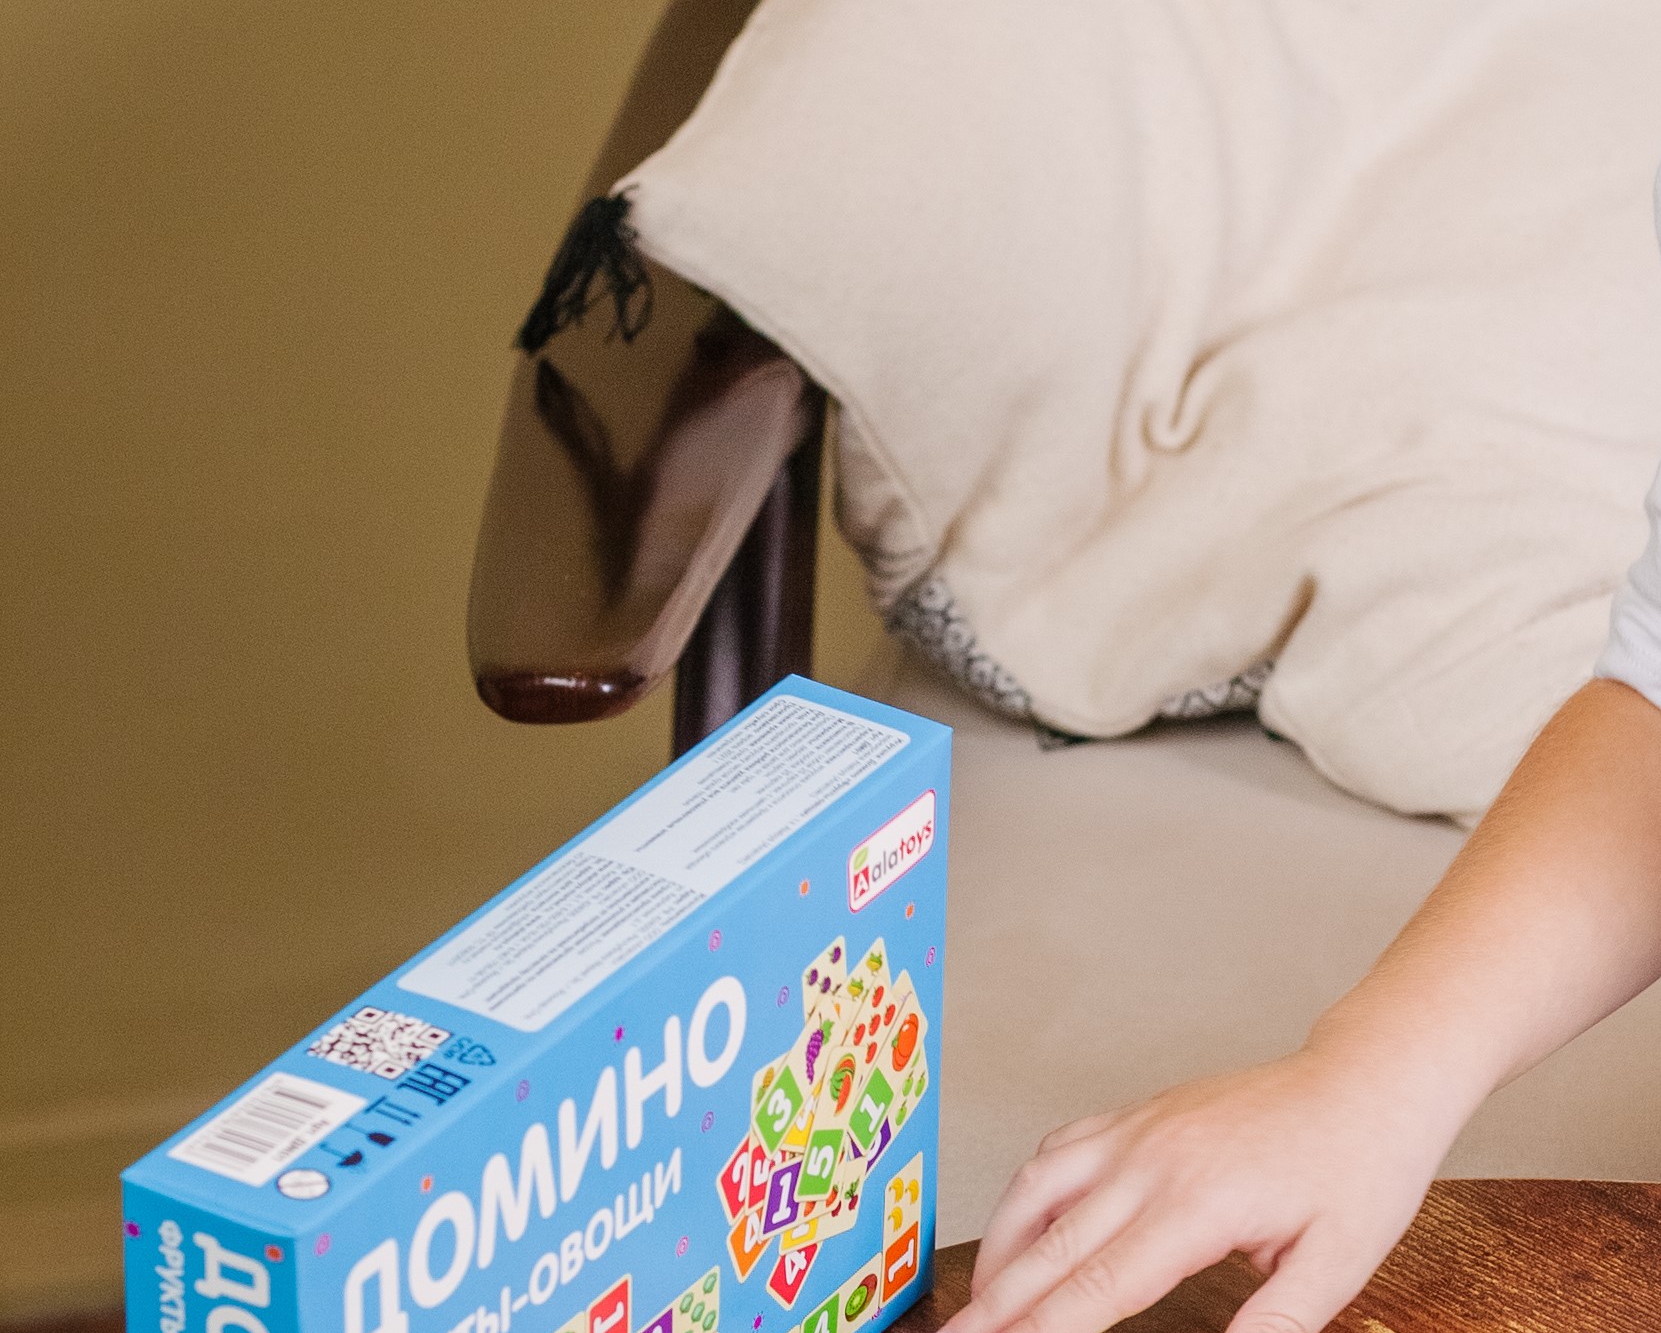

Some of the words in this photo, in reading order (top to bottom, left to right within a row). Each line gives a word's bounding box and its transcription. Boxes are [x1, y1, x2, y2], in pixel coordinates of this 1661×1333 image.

[767, 1088, 792, 1132] 3
[860, 1093, 886, 1133] 1
[806, 1145, 835, 1179] 5
[772, 1171, 792, 1224] 1
[785, 1248, 809, 1285] 4
[889, 1239, 914, 1282] 1
